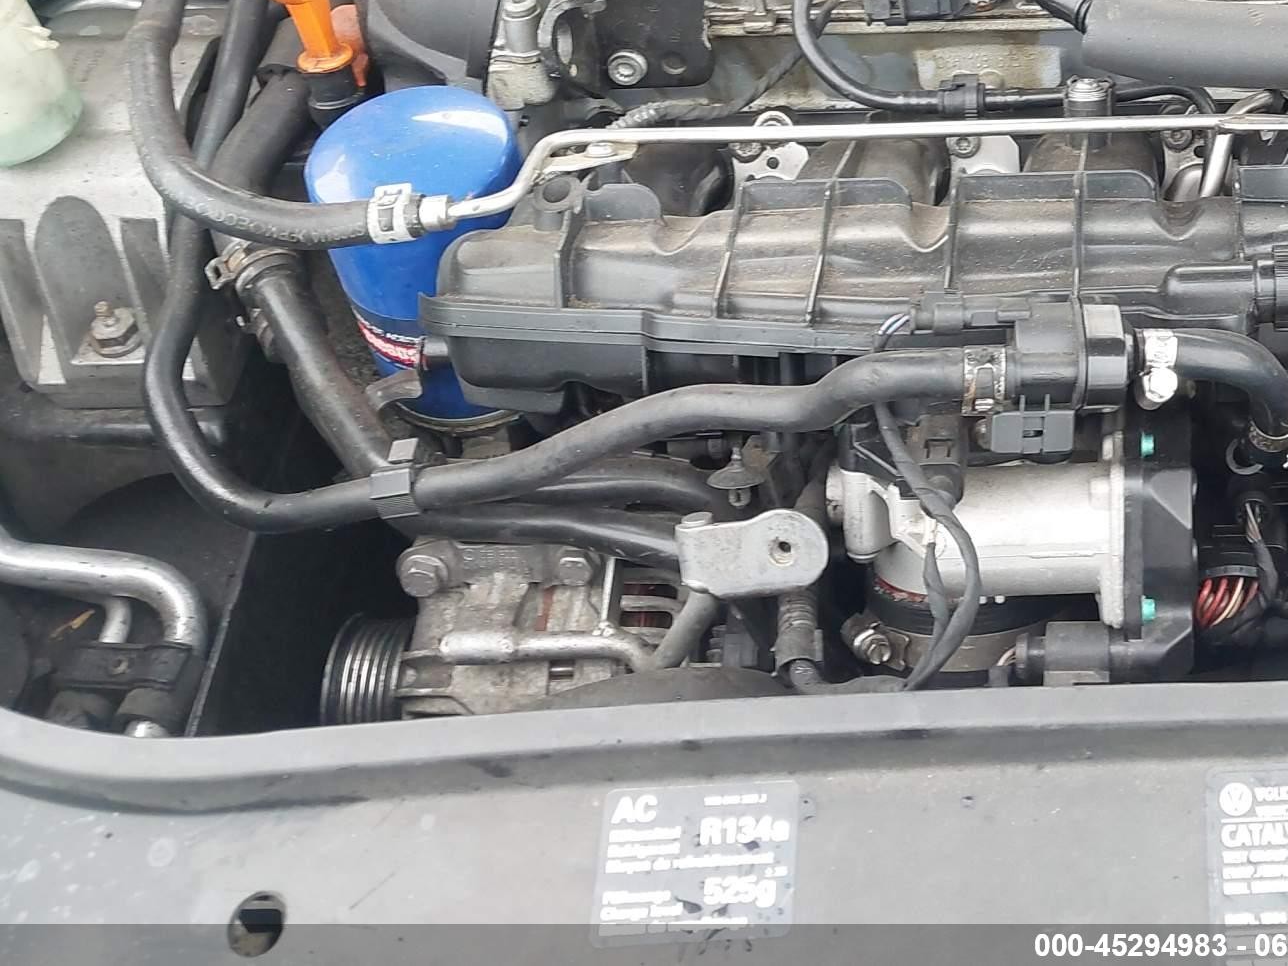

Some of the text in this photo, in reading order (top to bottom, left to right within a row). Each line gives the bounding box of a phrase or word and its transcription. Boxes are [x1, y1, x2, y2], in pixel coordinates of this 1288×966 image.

[610, 795, 658, 824] AC
[700, 815, 790, 846] R134a
[703, 875, 777, 908] 525g
